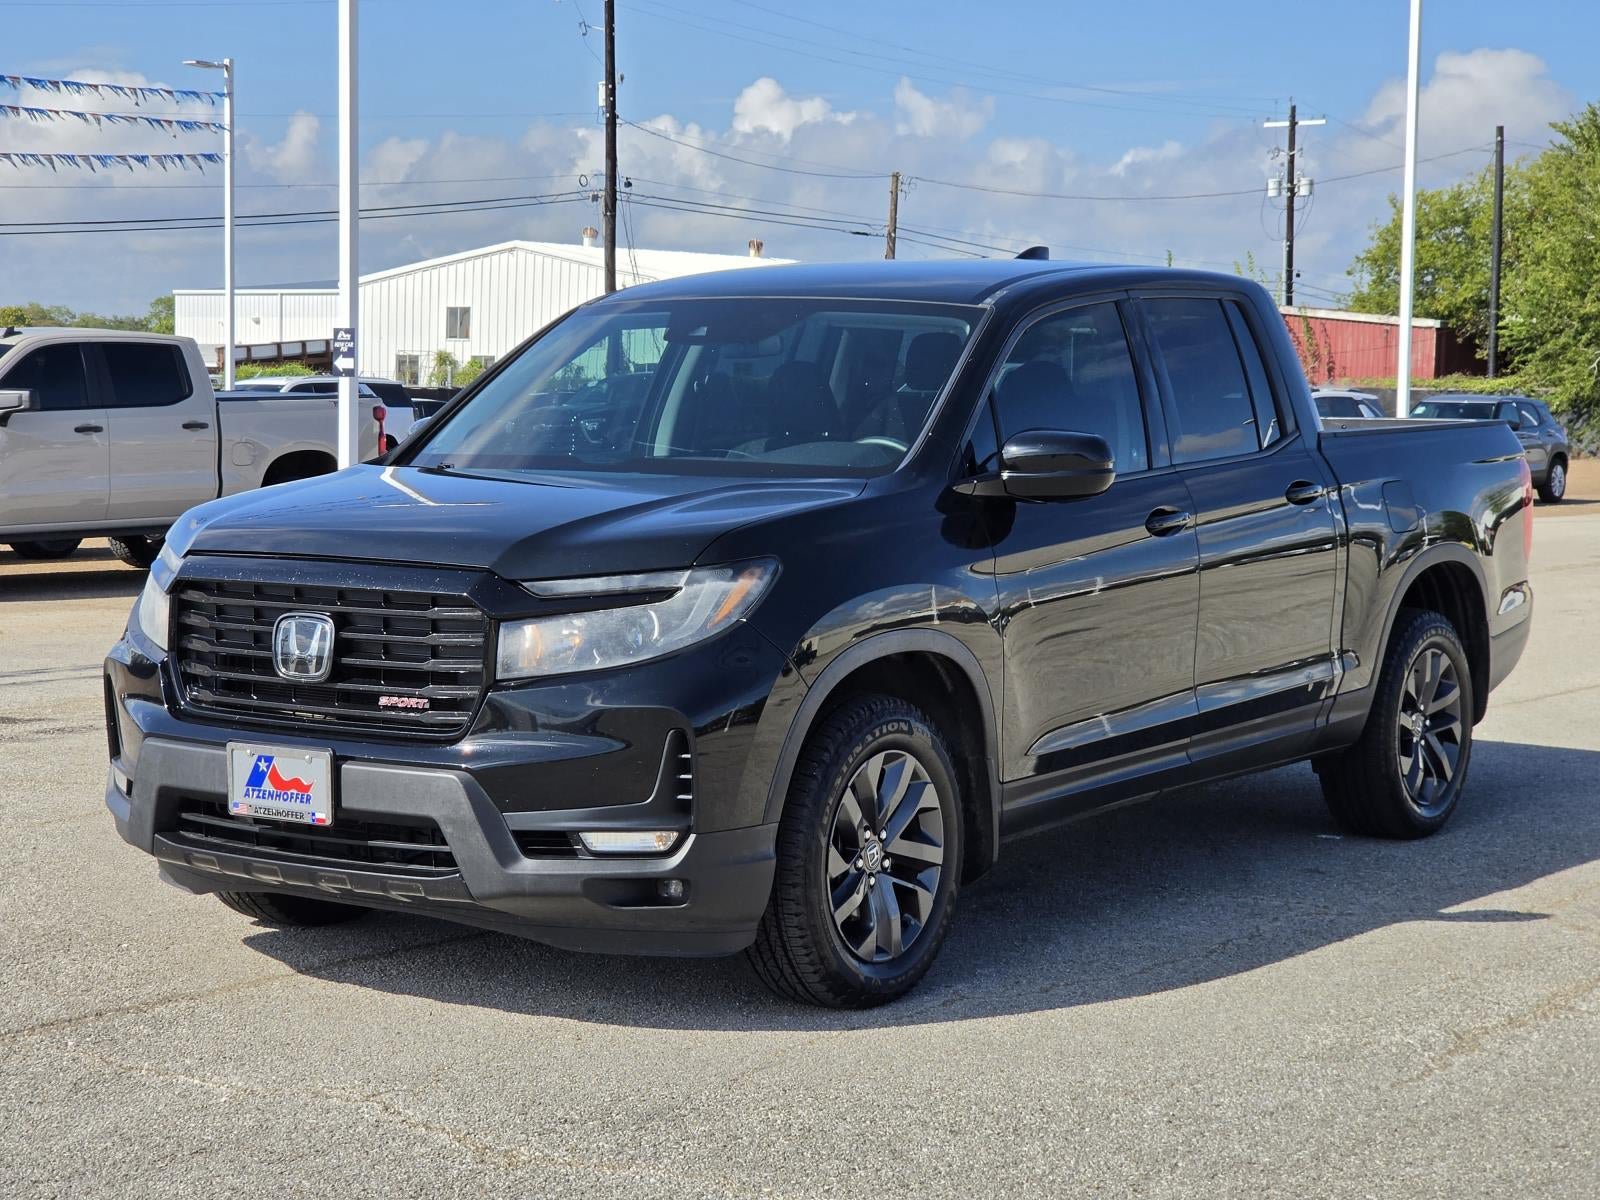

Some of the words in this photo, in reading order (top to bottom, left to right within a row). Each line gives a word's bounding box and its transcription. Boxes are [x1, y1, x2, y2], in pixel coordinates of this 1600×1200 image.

[378, 696, 428, 709] SPORT
[244, 788, 312, 805] ATZENHOFFER
[254, 806, 305, 820] ATZENHOFFER
